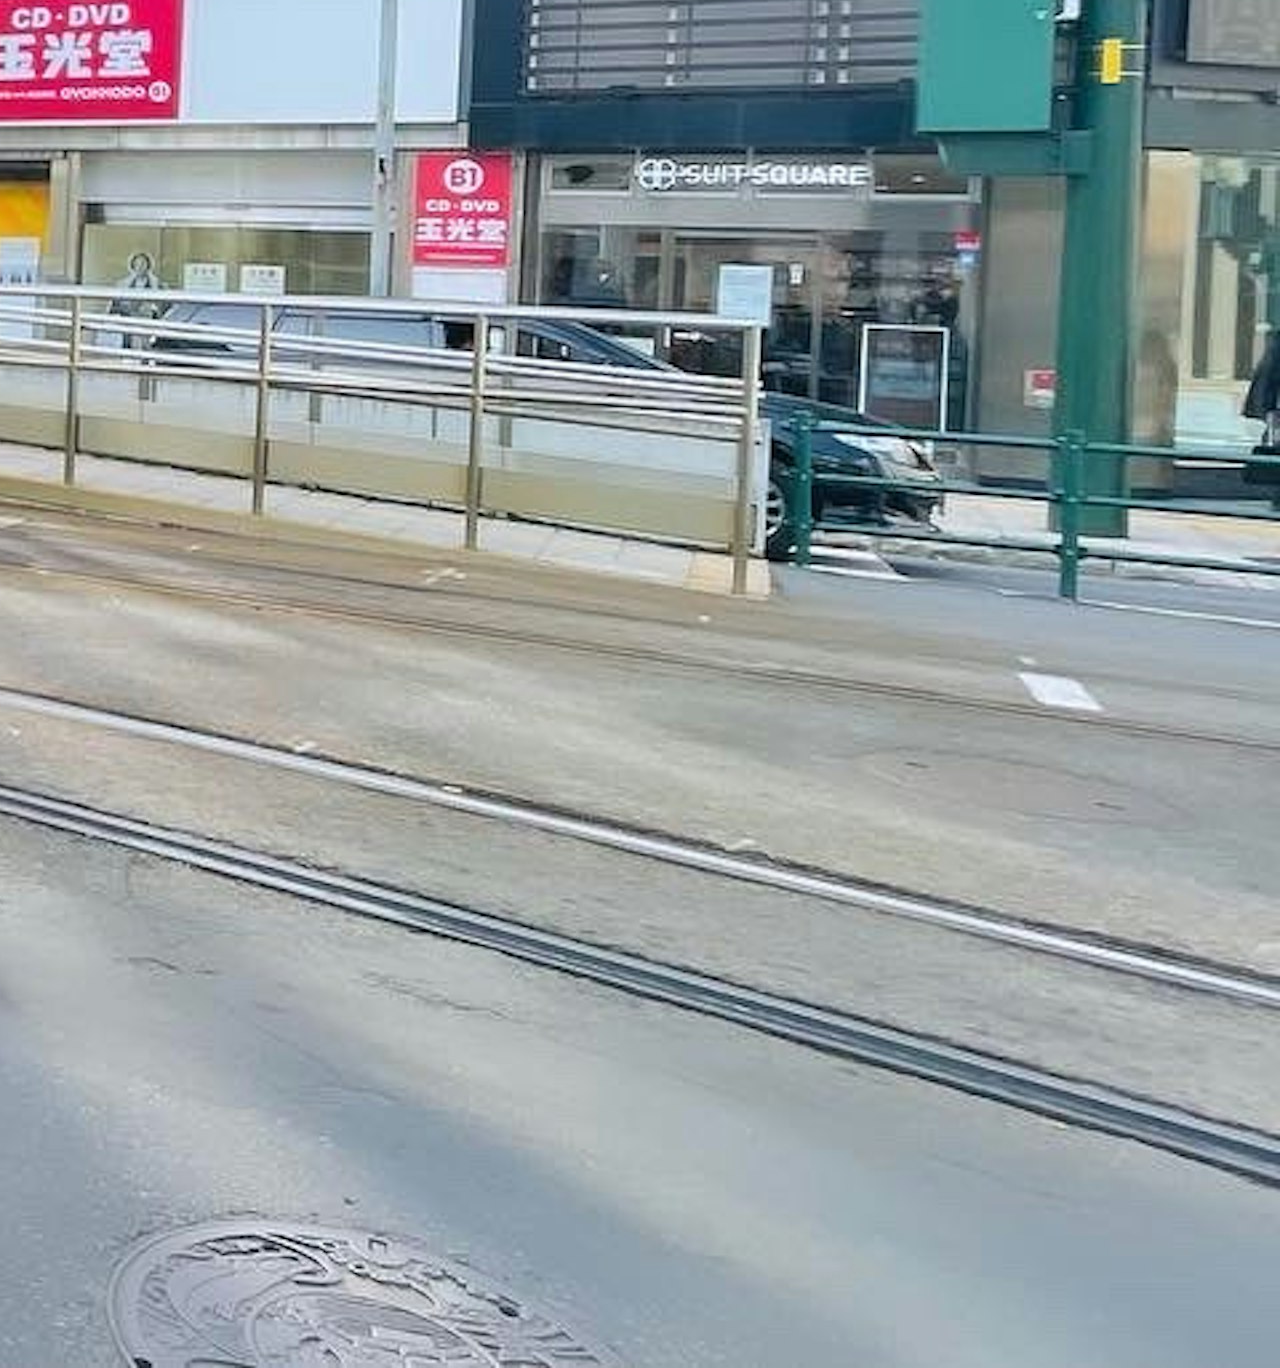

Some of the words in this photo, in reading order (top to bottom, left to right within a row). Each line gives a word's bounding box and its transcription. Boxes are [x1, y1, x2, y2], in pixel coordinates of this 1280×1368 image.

[450, 168, 477, 187] B1
[684, 164, 743, 185] SUIT
[751, 164, 868, 186] SQUARE
[416, 218, 507, 242] 玉光堂
